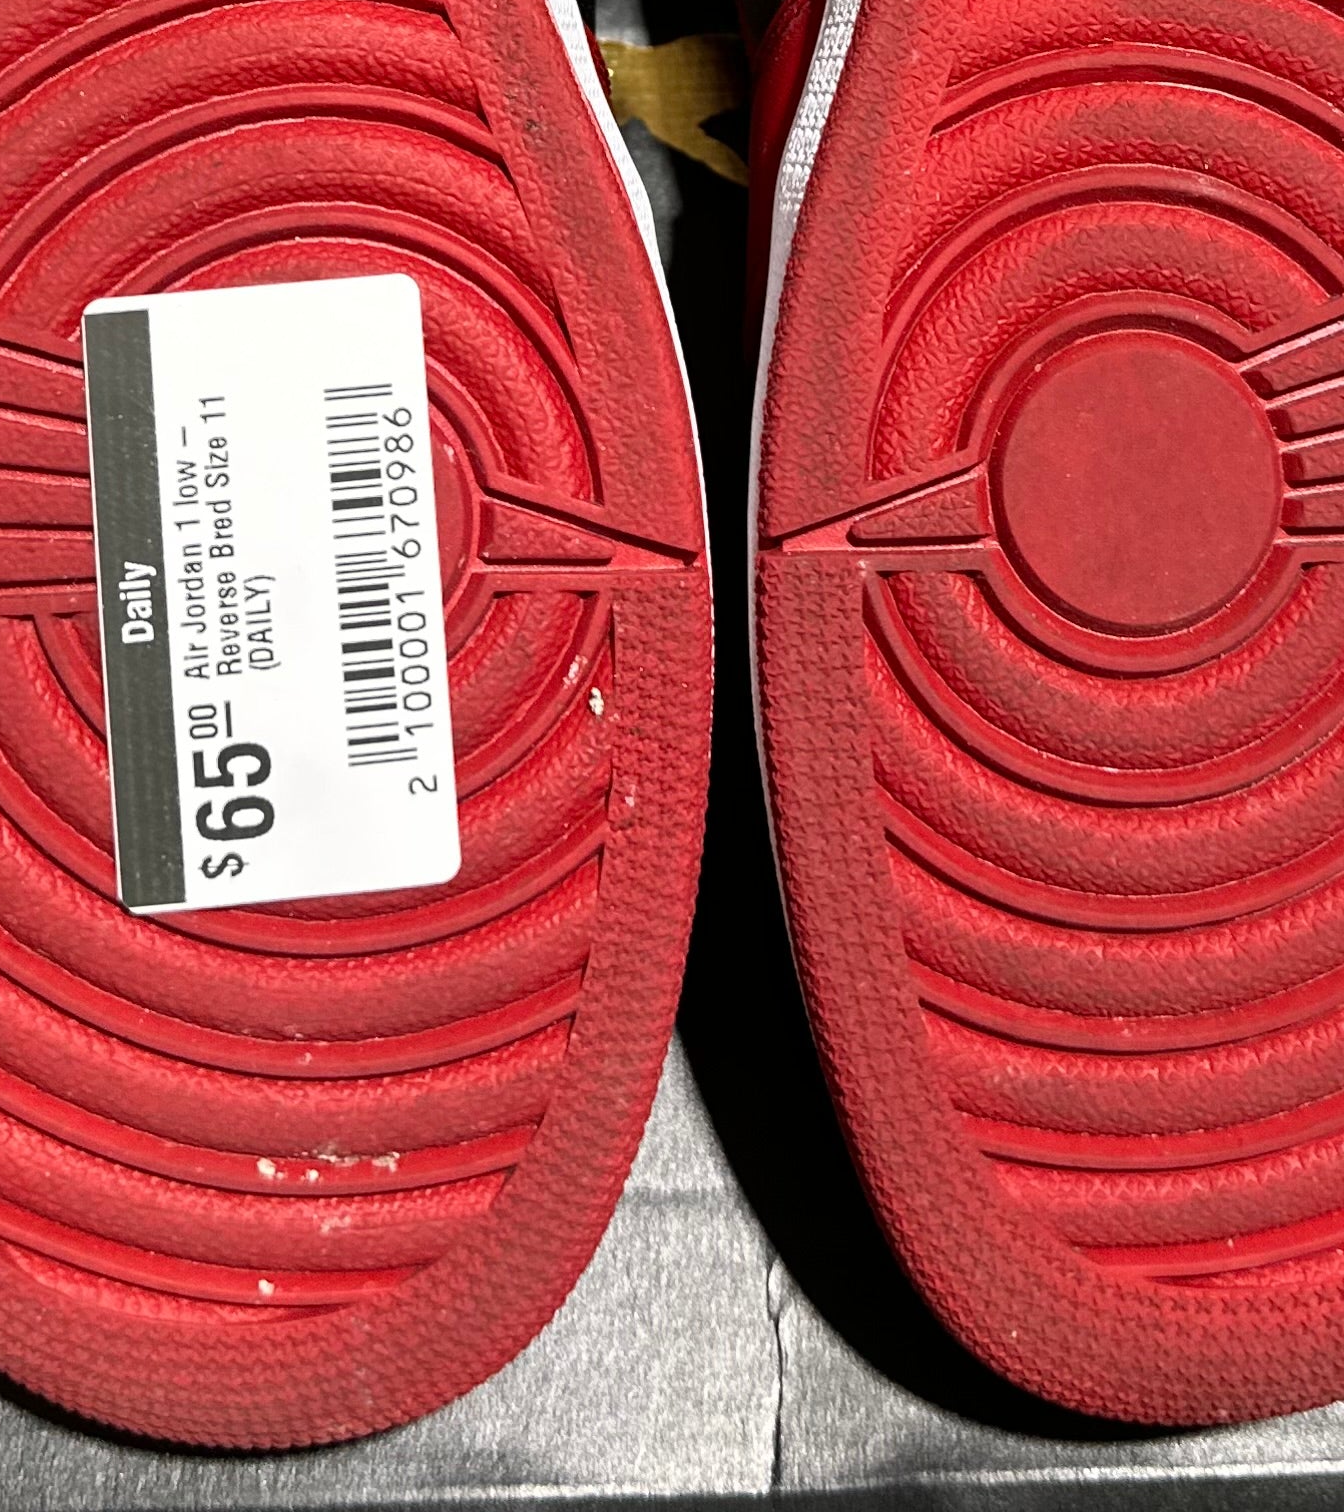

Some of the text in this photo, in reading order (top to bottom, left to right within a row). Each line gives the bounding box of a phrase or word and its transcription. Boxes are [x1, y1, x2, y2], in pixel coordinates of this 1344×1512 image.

[174, 461, 199, 506] low
[175, 520, 200, 530] 1
[383, 407, 421, 559] 670986
[200, 397, 242, 676] Reverse Bred Size 11
[120, 561, 157, 645] Daily
[179, 544, 208, 634] Jordan
[245, 576, 280, 672] (DAILY)
[183, 644, 210, 679] Air
[396, 591, 433, 736] 100001
